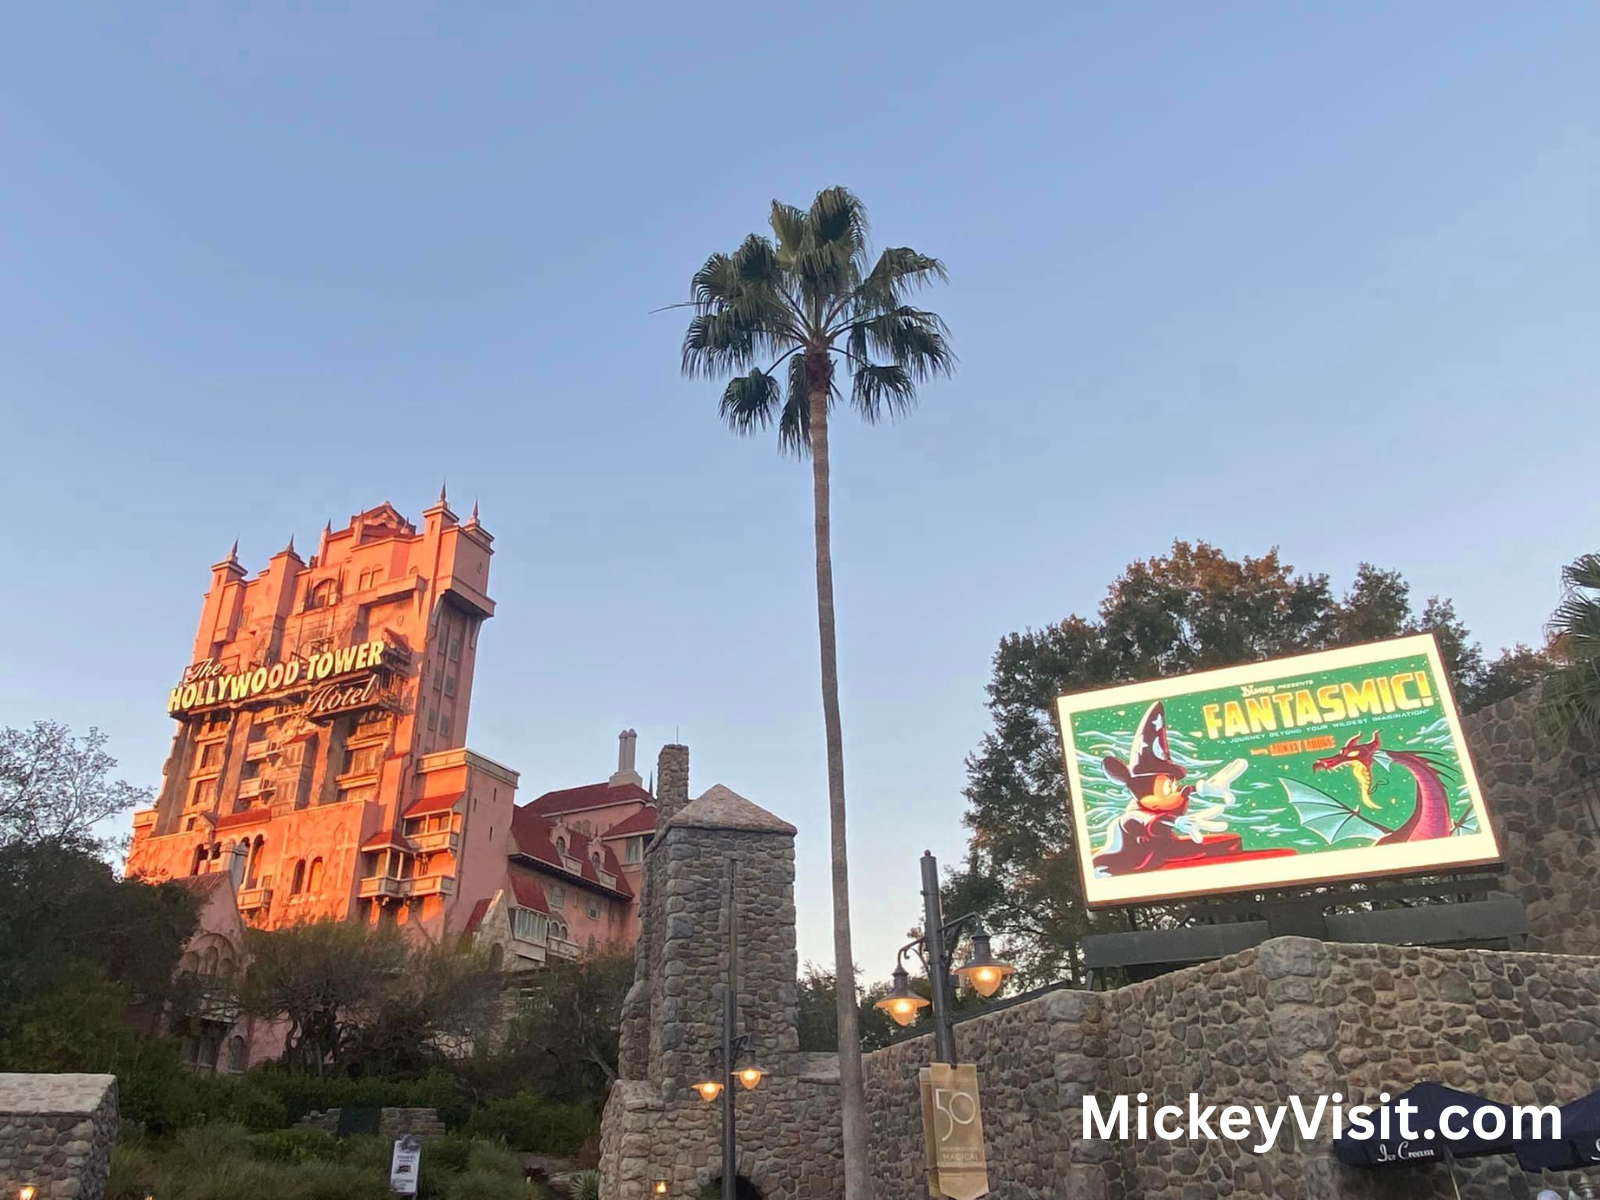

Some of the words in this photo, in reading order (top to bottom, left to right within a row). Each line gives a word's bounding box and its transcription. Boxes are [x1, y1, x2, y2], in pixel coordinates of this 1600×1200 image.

[168, 661, 299, 712] HOLLYWOOD
[307, 640, 385, 681] TOWER
[187, 657, 223, 682] The
[304, 674, 378, 717] Hotel
[1203, 670, 1435, 739] FANTASMIC!
[1240, 684, 1275, 698] Disney
[1277, 679, 1314, 690] PRESENTS
[1229, 733, 1266, 744] JOURNEY
[1269, 728, 1302, 738] BEYOND
[1306, 724, 1328, 732] YOUR
[1332, 718, 1368, 728] WILDEST
[935, 1088, 976, 1141] 50
[1397, 1140, 1435, 1160] Cream
